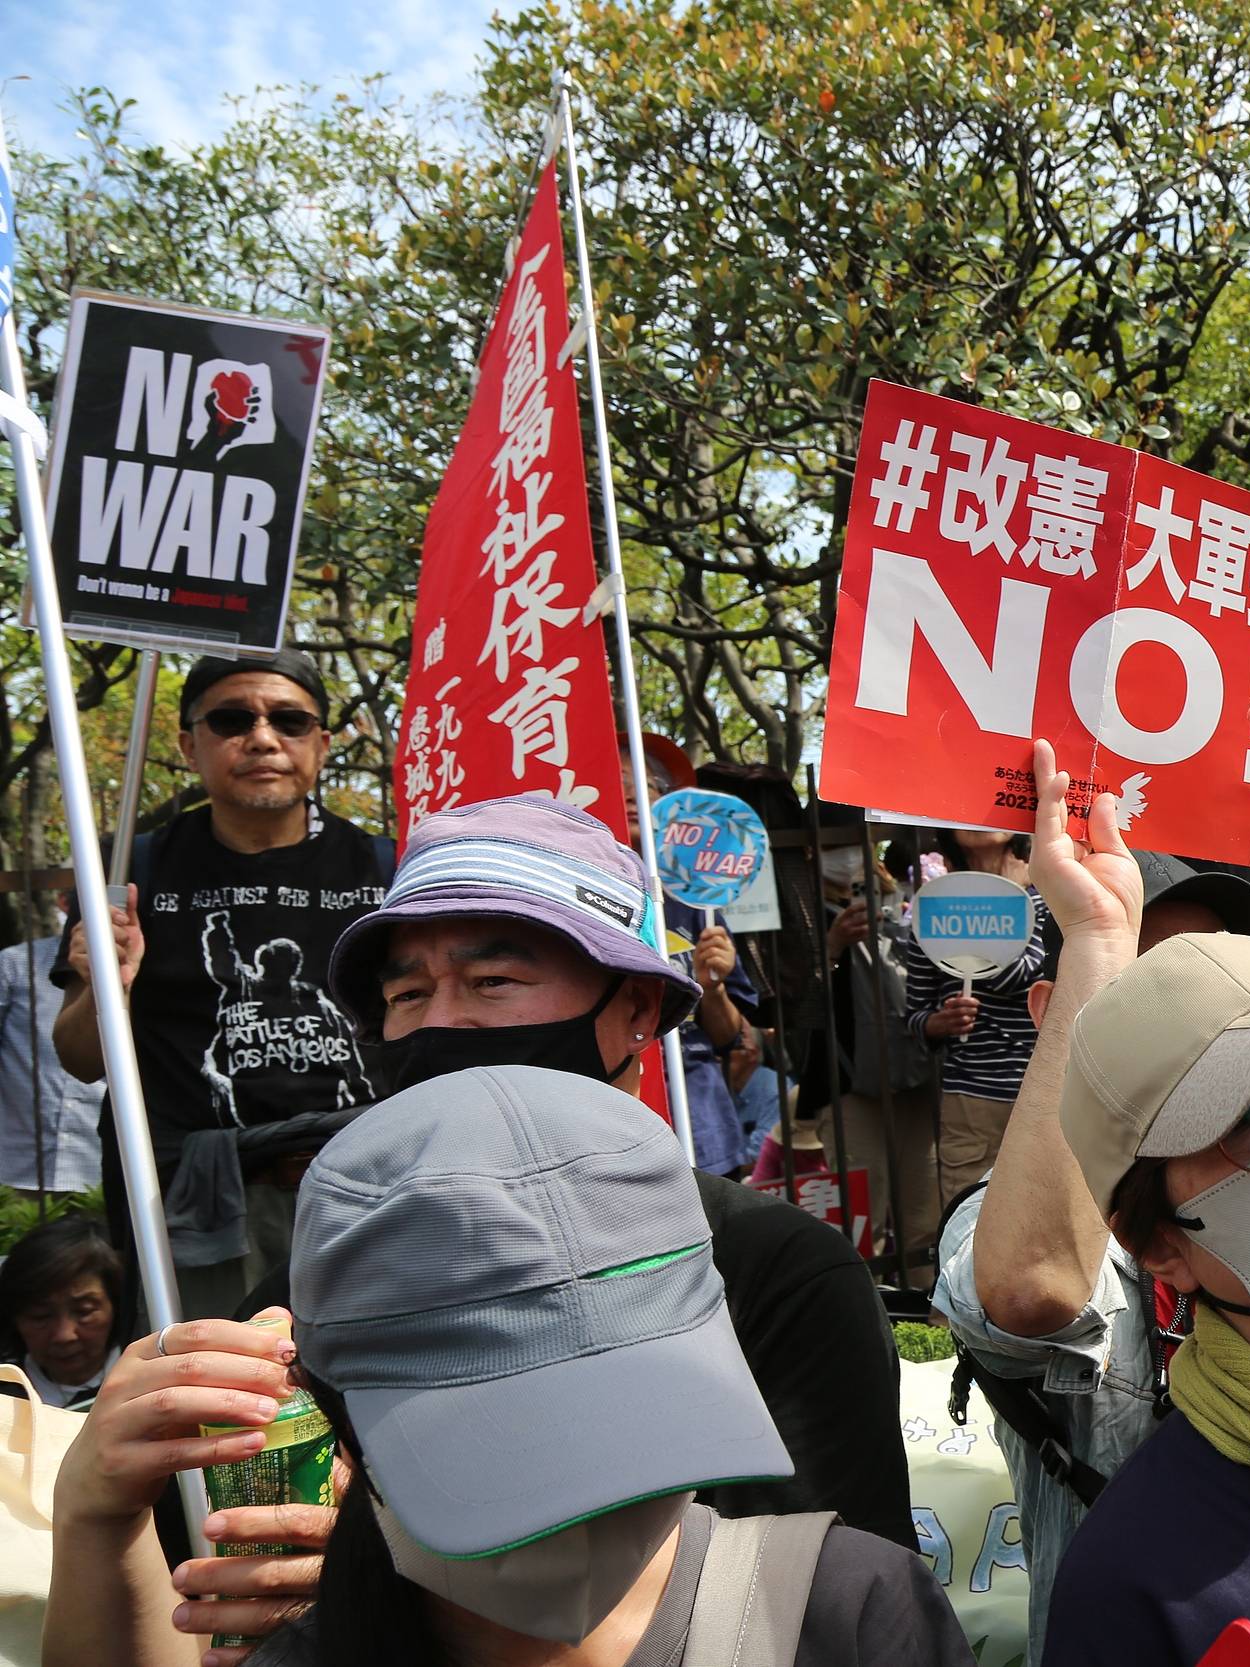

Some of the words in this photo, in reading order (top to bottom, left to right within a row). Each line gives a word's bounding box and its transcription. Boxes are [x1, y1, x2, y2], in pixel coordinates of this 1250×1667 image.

[870, 419, 1109, 581] #改憲
[78, 455, 276, 586] WAR
[694, 850, 755, 878] WAR
[278, 886, 310, 907] THE
[320, 886, 386, 910] MACHIN
[594, 893, 628, 918] Columbia
[931, 914, 962, 936] NO
[966, 914, 1015, 936] WAR
[220, 1001, 263, 1026] THE
[225, 1018, 293, 1048] BATTLE
[294, 1015, 322, 1037] OF
[228, 1050, 263, 1076] LOS
